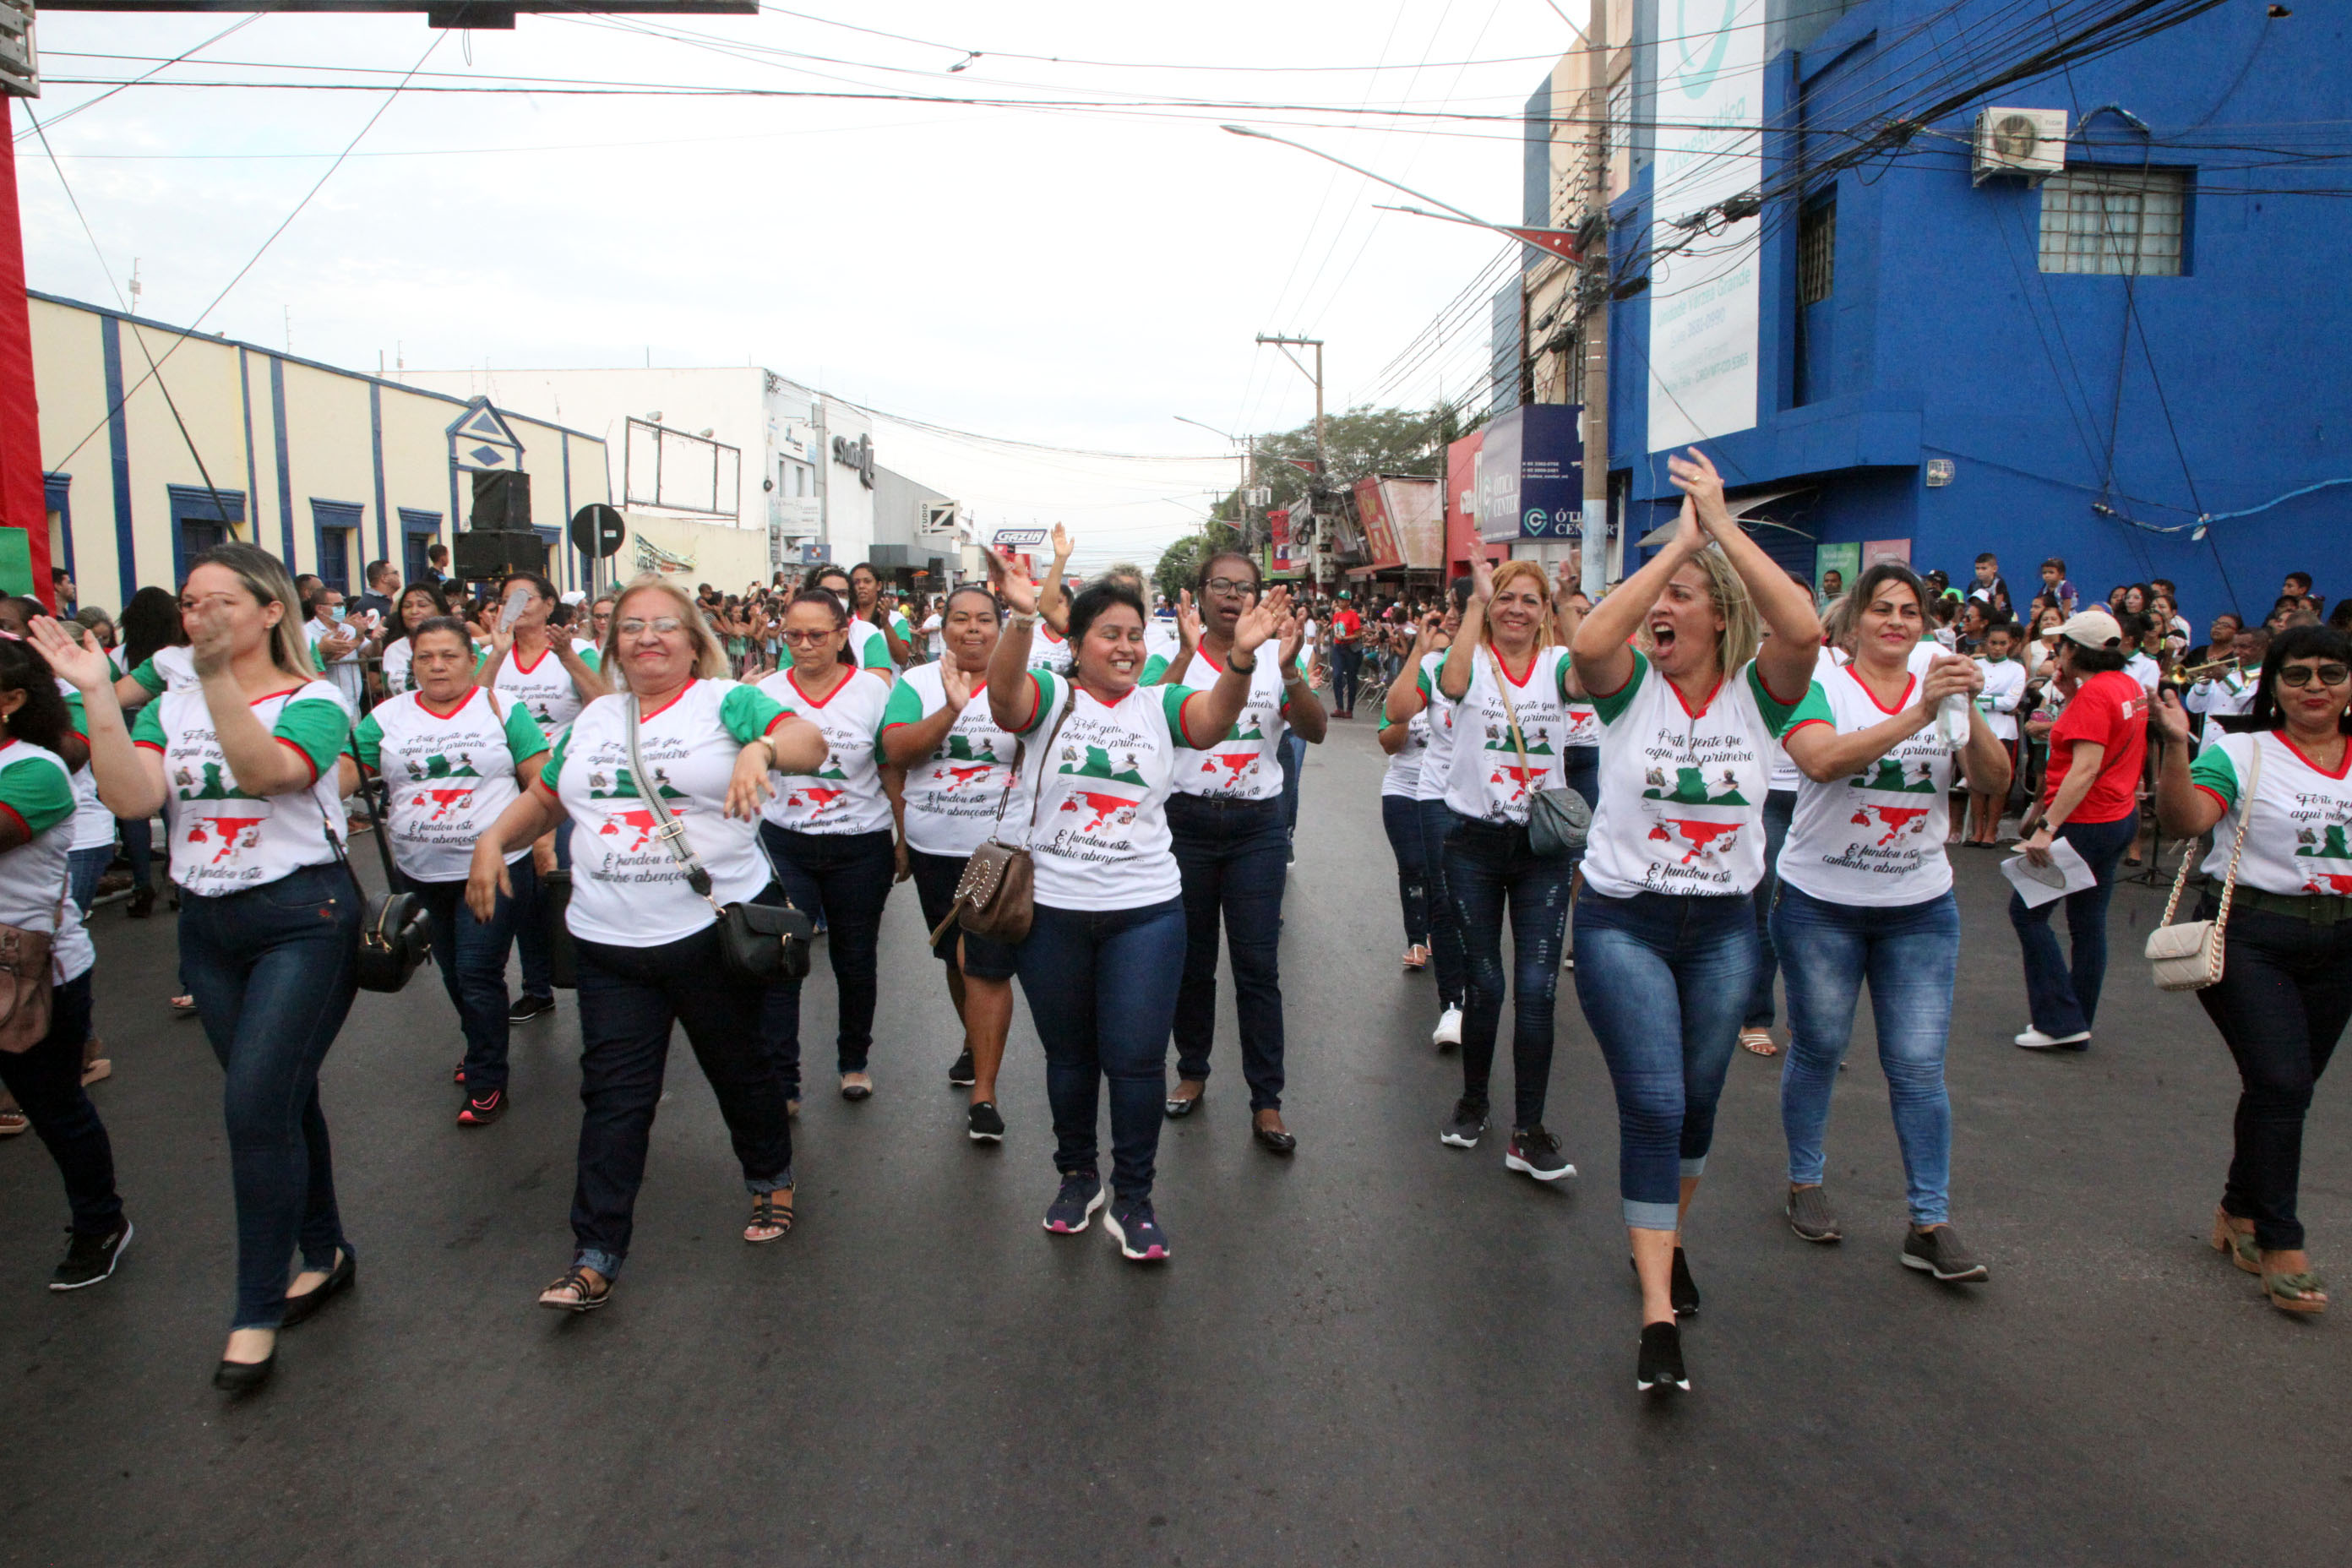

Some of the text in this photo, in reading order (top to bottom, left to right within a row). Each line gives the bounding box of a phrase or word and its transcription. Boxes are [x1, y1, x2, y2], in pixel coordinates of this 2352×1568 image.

[1554, 508, 1583, 523] ÓTI
[1514, 700, 1538, 714] gente
[962, 714, 987, 725] gente
[836, 729, 854, 738] que
[1690, 735, 1723, 750] gente
[399, 746, 422, 757] aqui
[1645, 747, 1673, 762] aqui
[1701, 750, 1755, 764] primeiro
[936, 792, 967, 805] fundou
[969, 793, 988, 804] este
[2295, 792, 2333, 807] Forte
[2290, 808, 2322, 823] aqui
[1054, 829, 1132, 852] E fundou este
[1035, 843, 1079, 859] cantinho
[1845, 842, 1859, 858] E
[1859, 844, 1901, 858] fundou
[603, 852, 614, 869] E
[616, 852, 662, 870] fundou
[1822, 854, 1871, 871] cantinho
[1647, 862, 1661, 880] E
[1662, 863, 1711, 881] fundou
